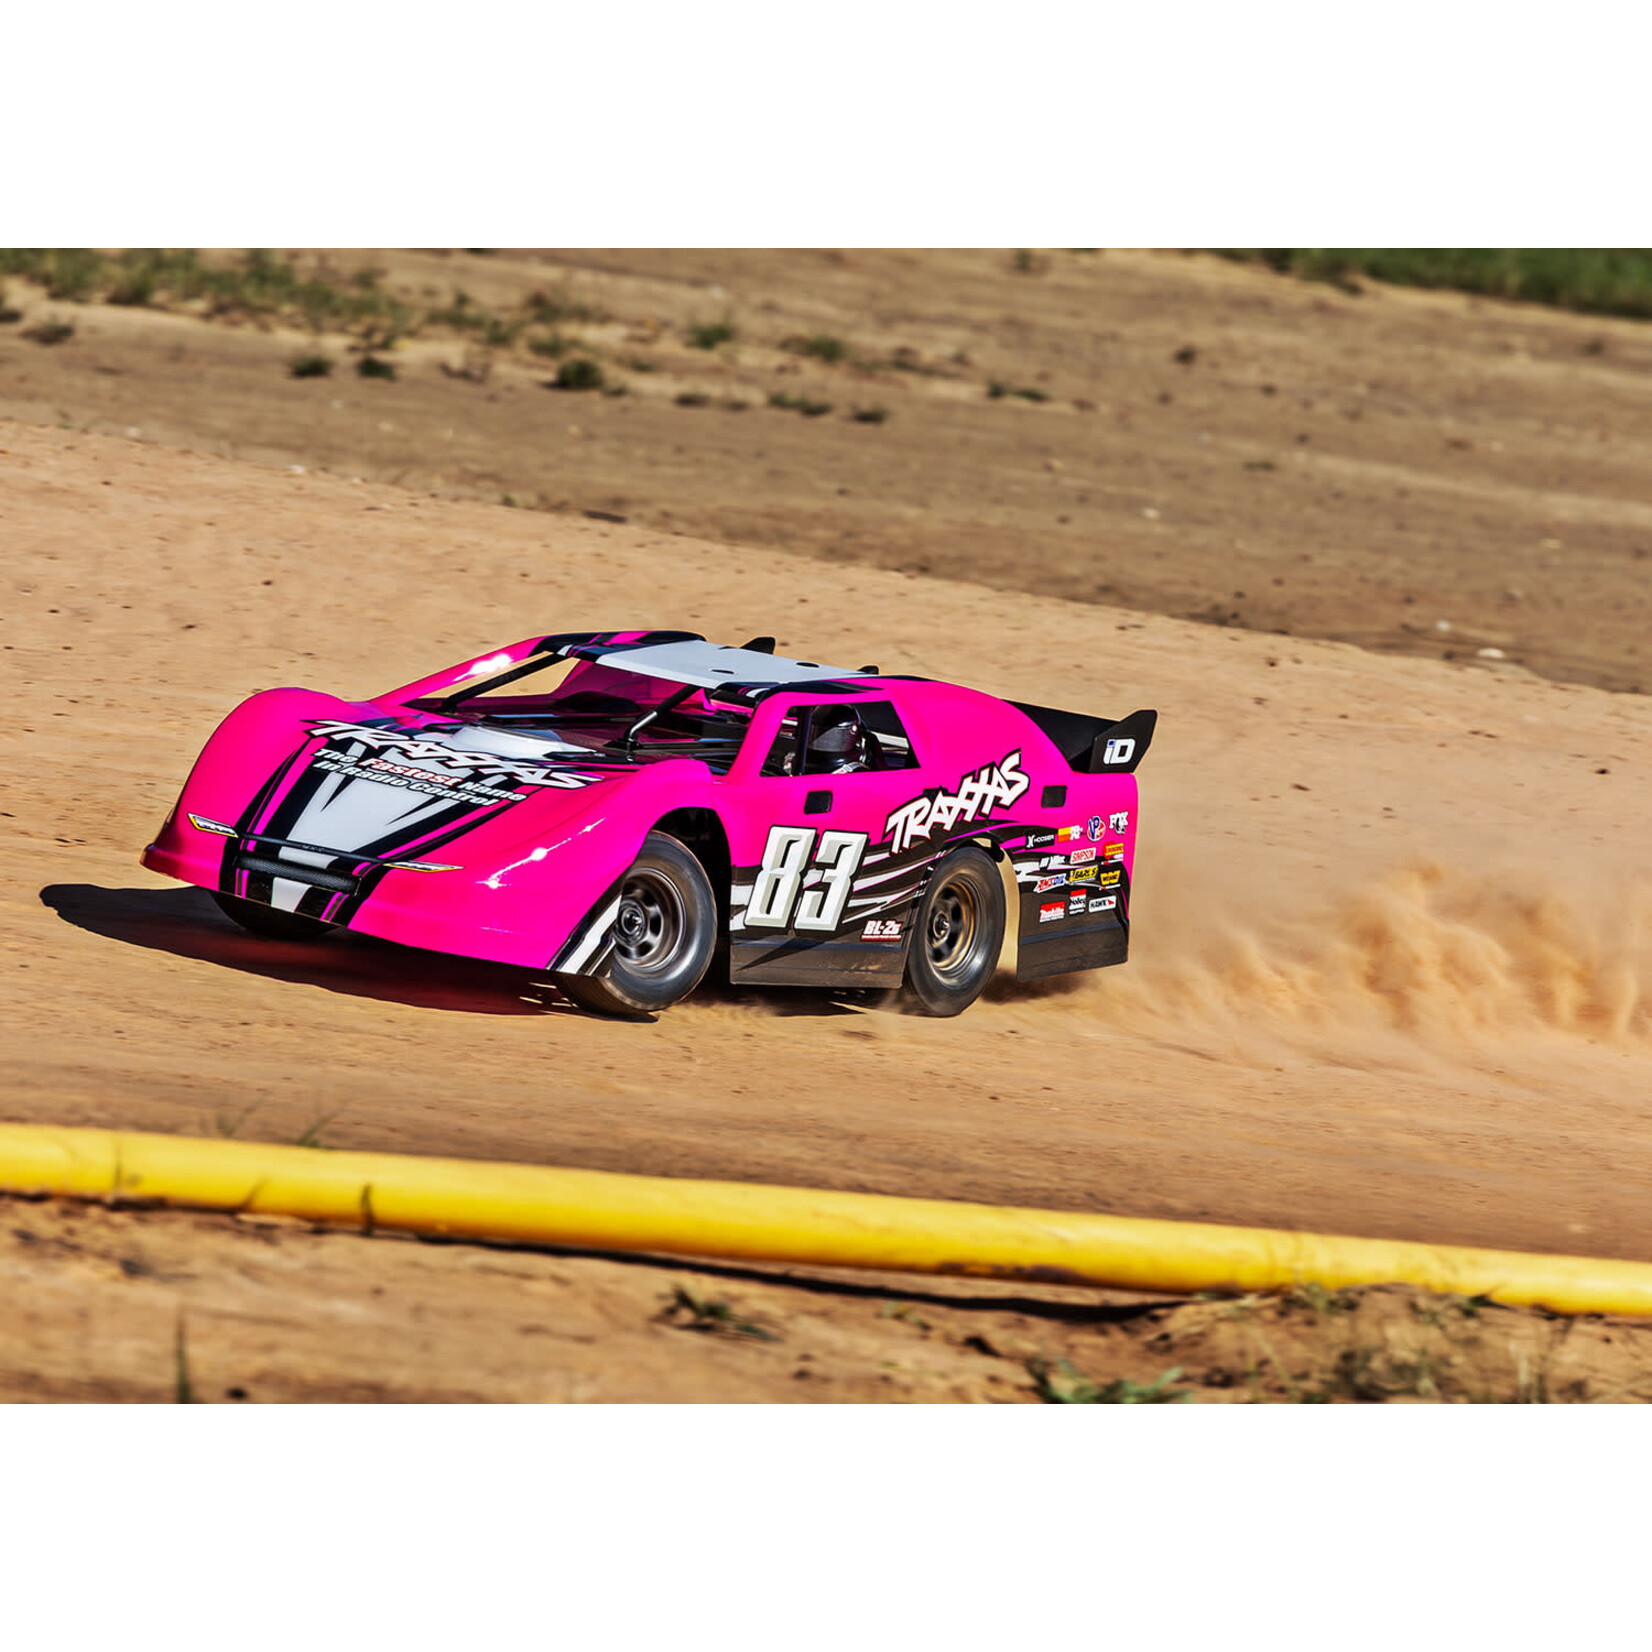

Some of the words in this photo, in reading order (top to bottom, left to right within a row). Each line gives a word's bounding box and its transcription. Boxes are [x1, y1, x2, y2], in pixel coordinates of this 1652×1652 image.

[304, 718, 604, 790] TRAXXAS
[312, 760, 342, 772] In
[339, 765, 410, 787] Radio
[407, 782, 500, 807] Control
[313, 748, 359, 763] The
[356, 757, 464, 788] Fastest
[456, 781, 528, 802] Name
[885, 751, 1029, 854] TRAXXAS
[744, 825, 869, 932] 83
